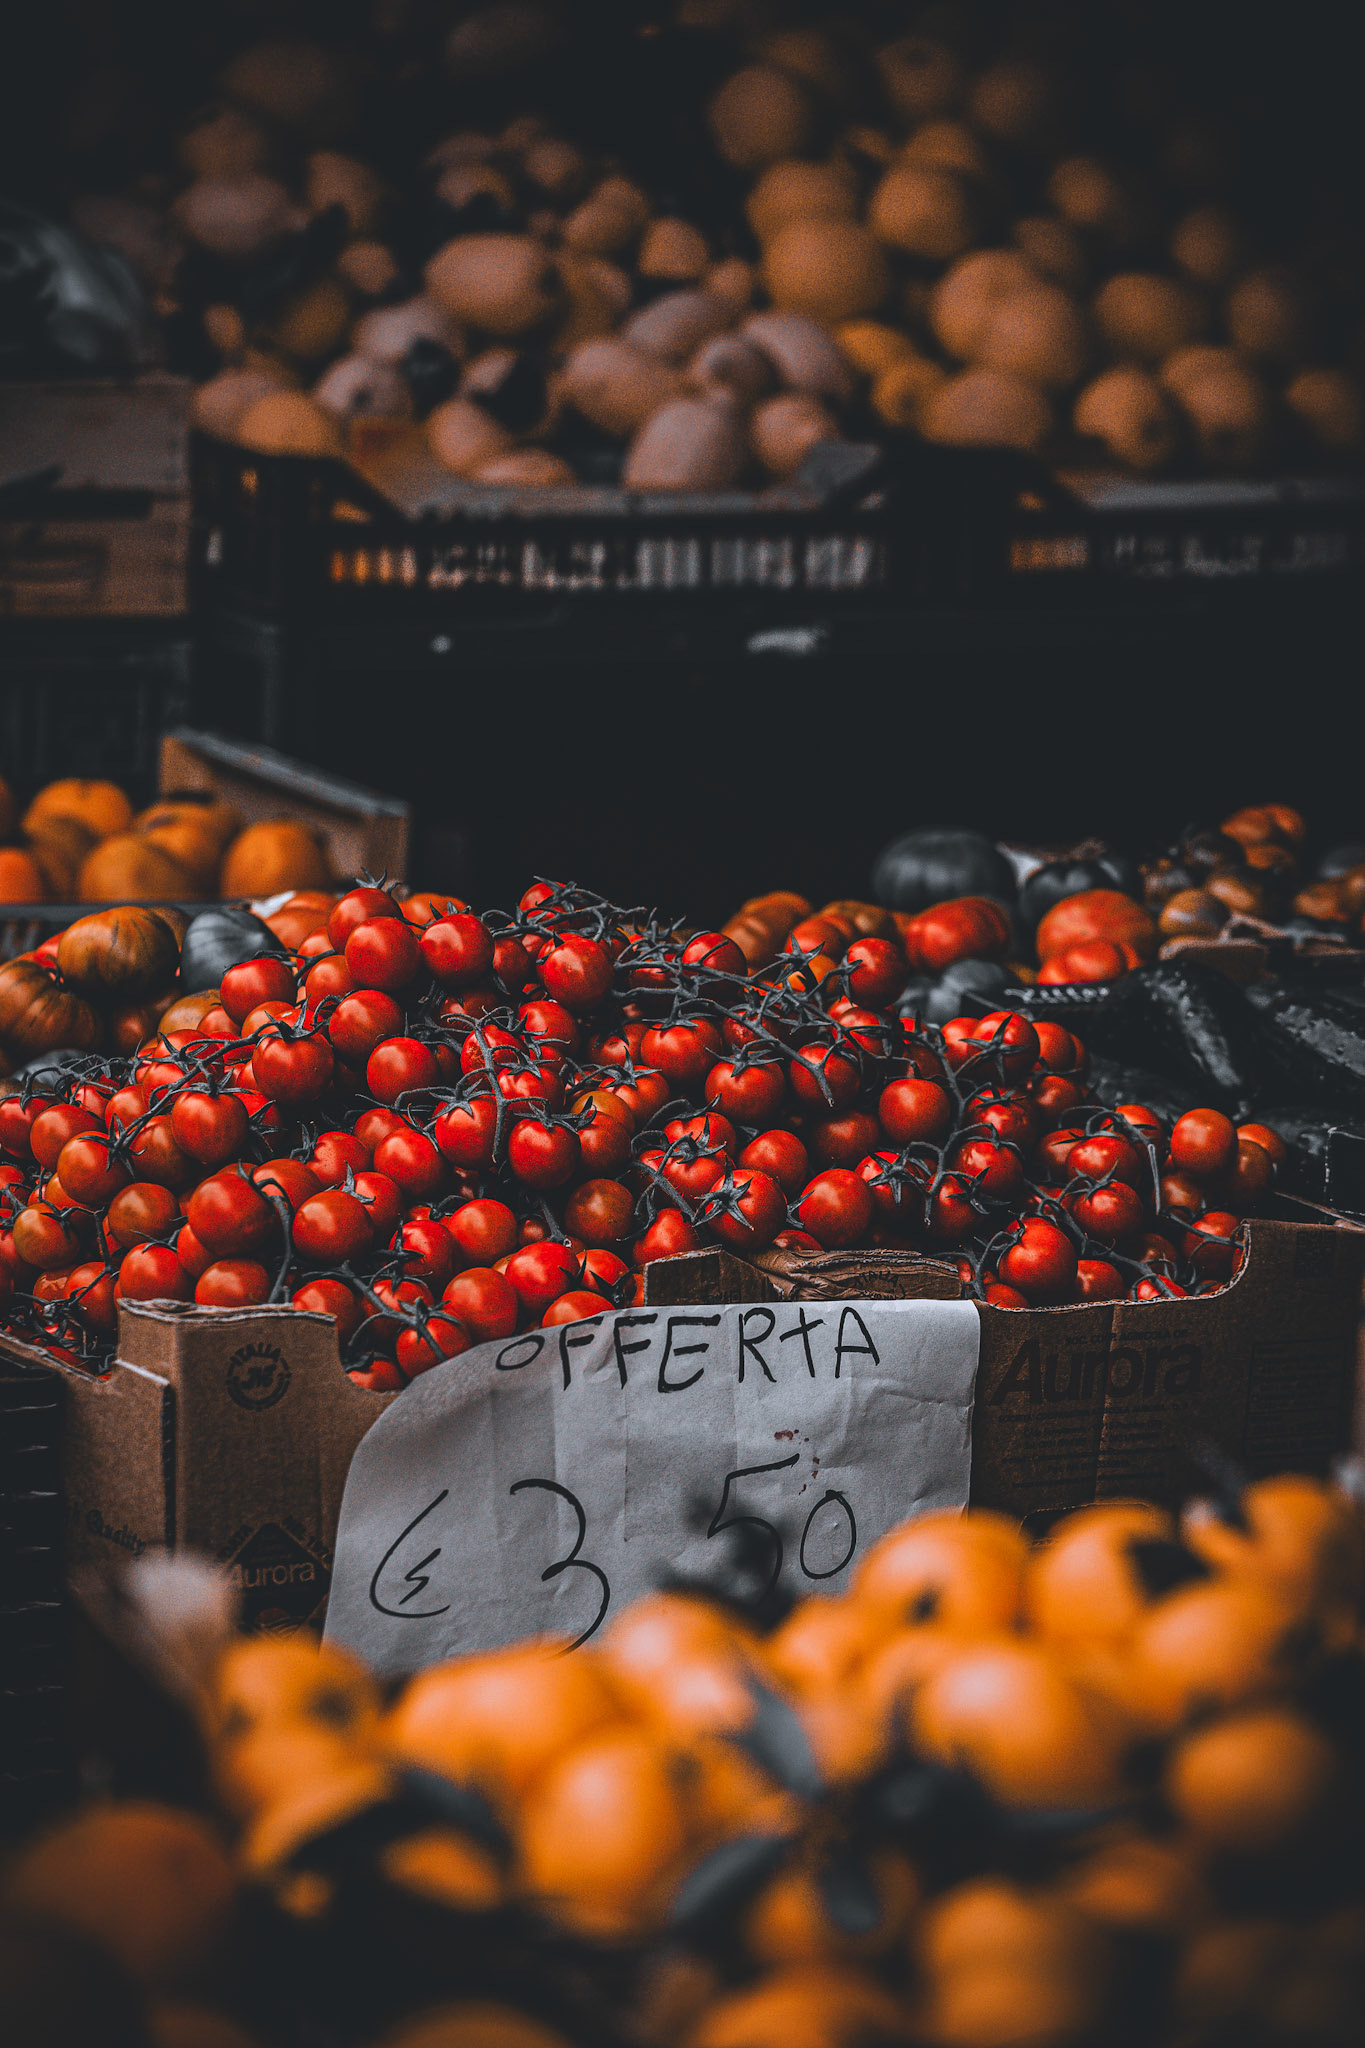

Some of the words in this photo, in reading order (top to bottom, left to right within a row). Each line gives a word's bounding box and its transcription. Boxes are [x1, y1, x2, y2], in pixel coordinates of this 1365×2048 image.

[495, 1305, 880, 1393] OFFERTA
[987, 1337, 1203, 1407] Aurora
[509, 1477, 611, 1657] 3
